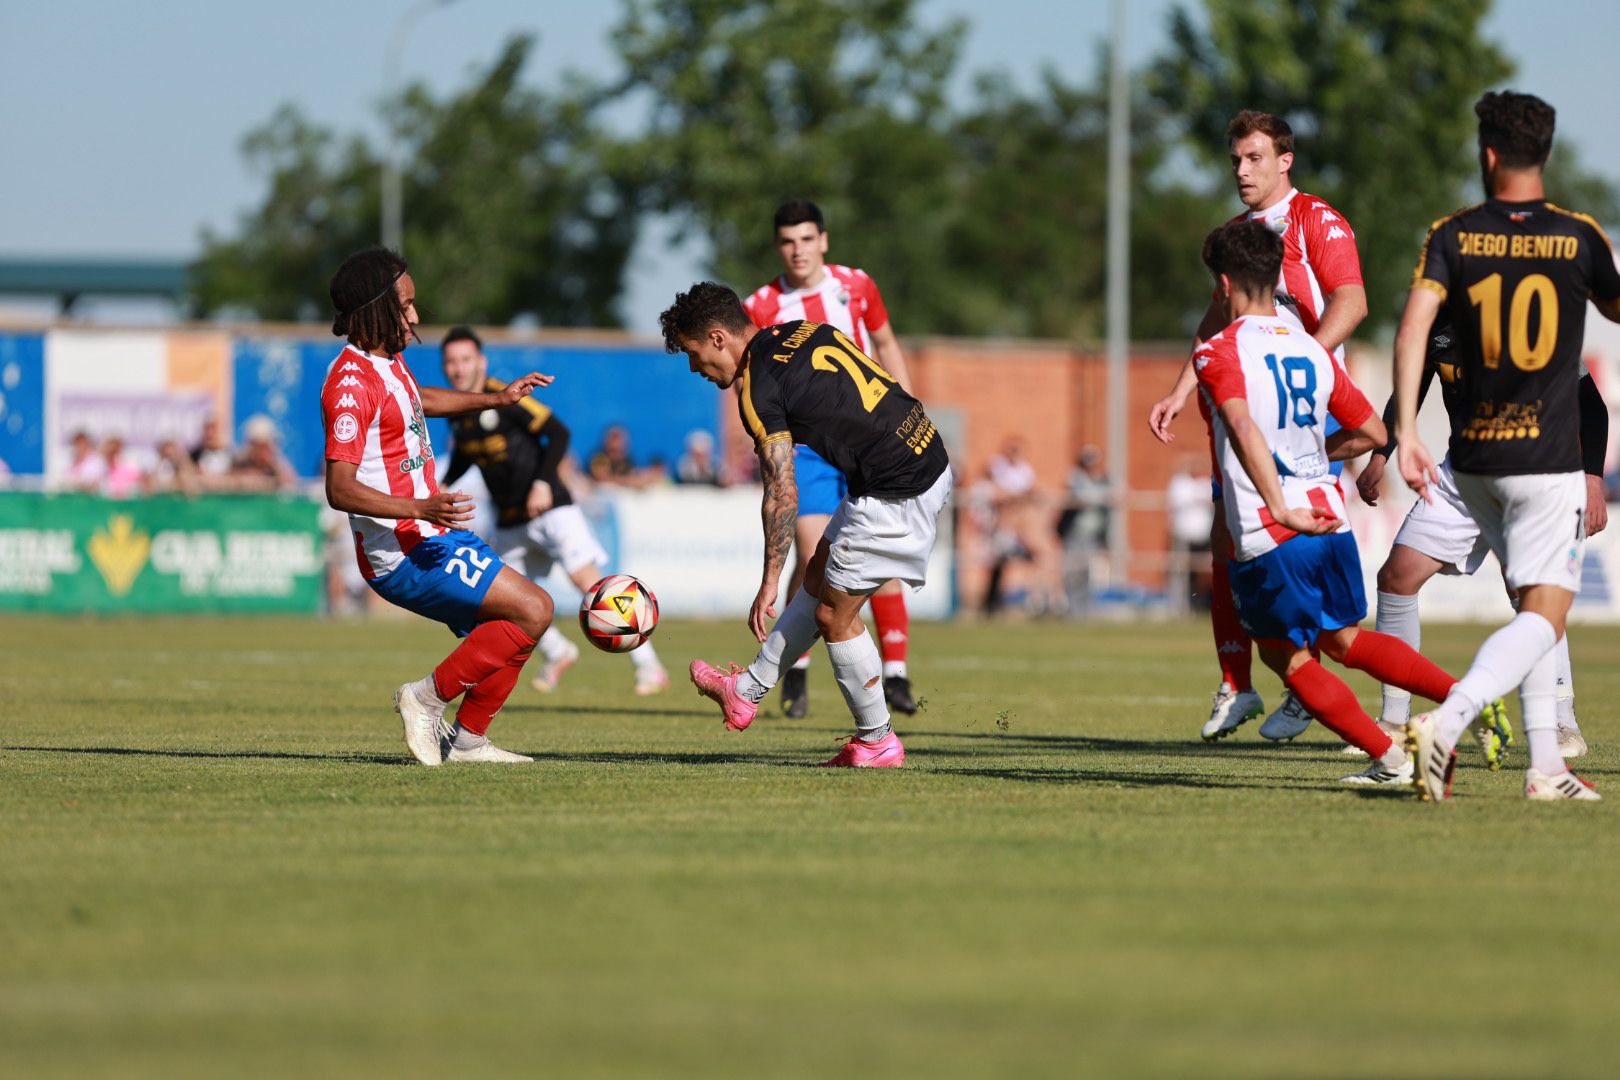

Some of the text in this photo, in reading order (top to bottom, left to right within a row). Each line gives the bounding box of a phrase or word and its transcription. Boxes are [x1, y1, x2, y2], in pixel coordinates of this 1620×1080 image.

[1510, 234, 1579, 260] BENITO
[1467, 272, 1559, 371] 10
[773, 351, 795, 364] A.
[1264, 353, 1318, 430] 18
[445, 547, 493, 588] 22
